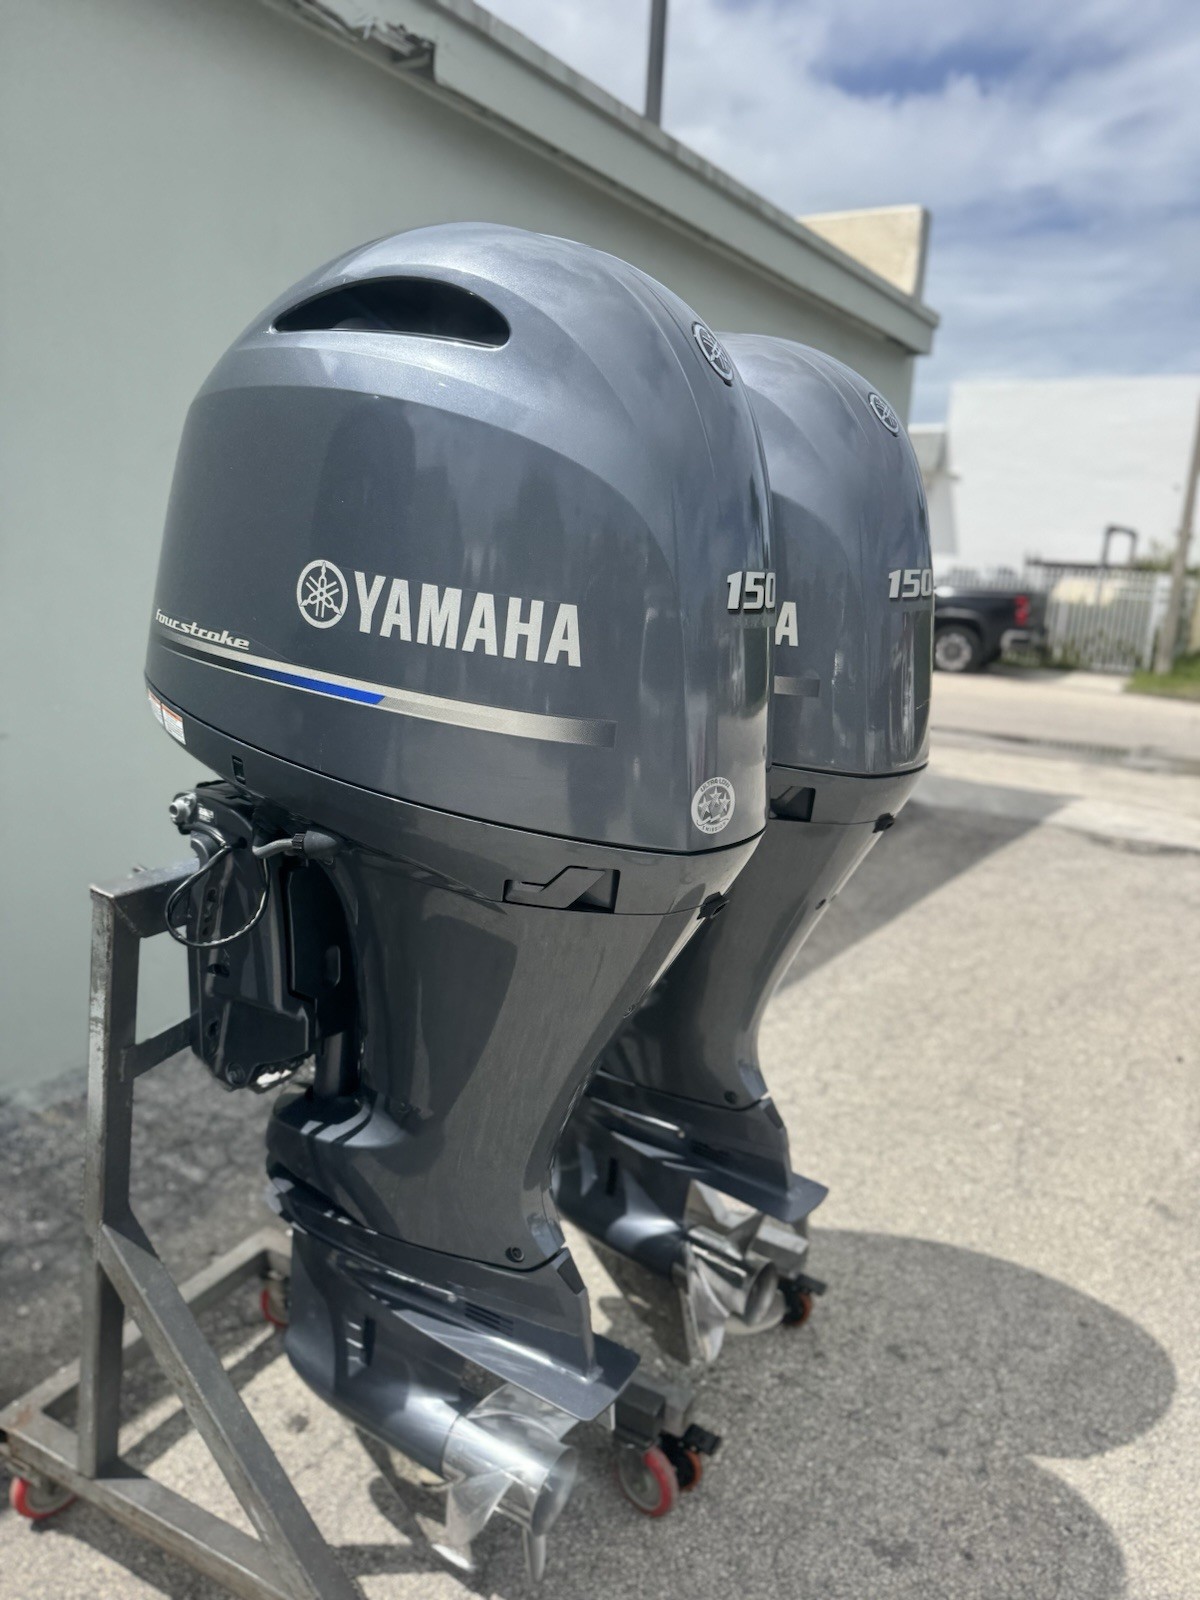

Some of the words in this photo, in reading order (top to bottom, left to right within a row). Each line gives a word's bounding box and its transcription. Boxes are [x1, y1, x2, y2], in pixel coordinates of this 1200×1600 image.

[727, 571, 776, 609] 150
[888, 569, 932, 598] 150
[354, 571, 582, 667] YAMAHA
